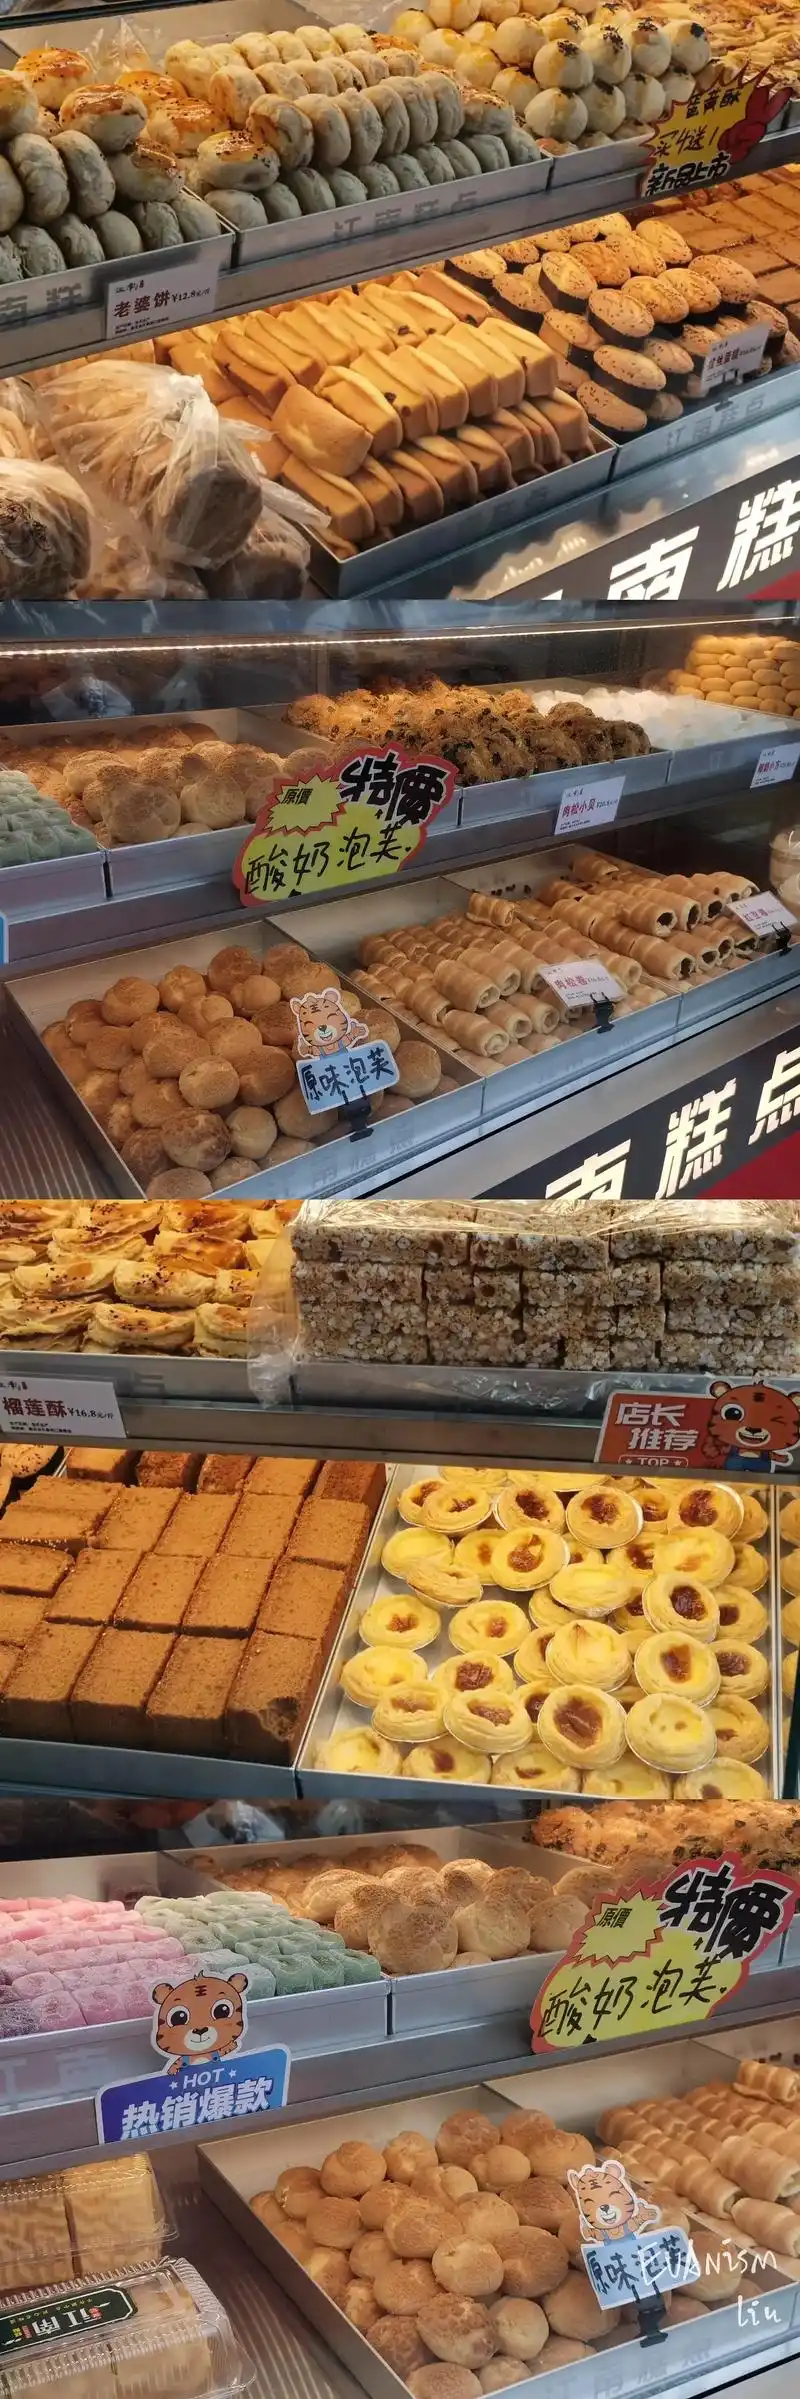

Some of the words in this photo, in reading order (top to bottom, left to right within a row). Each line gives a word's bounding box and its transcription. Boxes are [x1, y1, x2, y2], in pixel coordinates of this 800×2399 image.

[644, 151, 731, 198] 新品上市
[113, 289, 171, 317] 老婆饼
[281, 787, 312, 806] 原價
[301, 1046, 394, 1101] 原味泡芙
[3, 1397, 67, 1418] 榴莲酥
[614, 1402, 687, 1427] 店长
[628, 1427, 699, 1451] 推荐
[637, 1457, 670, 1467] TOP
[597, 1907, 632, 1928] 原價
[183, 2067, 225, 2090] HOT
[120, 2076, 274, 2140] 热销爆款
[31, 2306, 92, 2337] 江南
